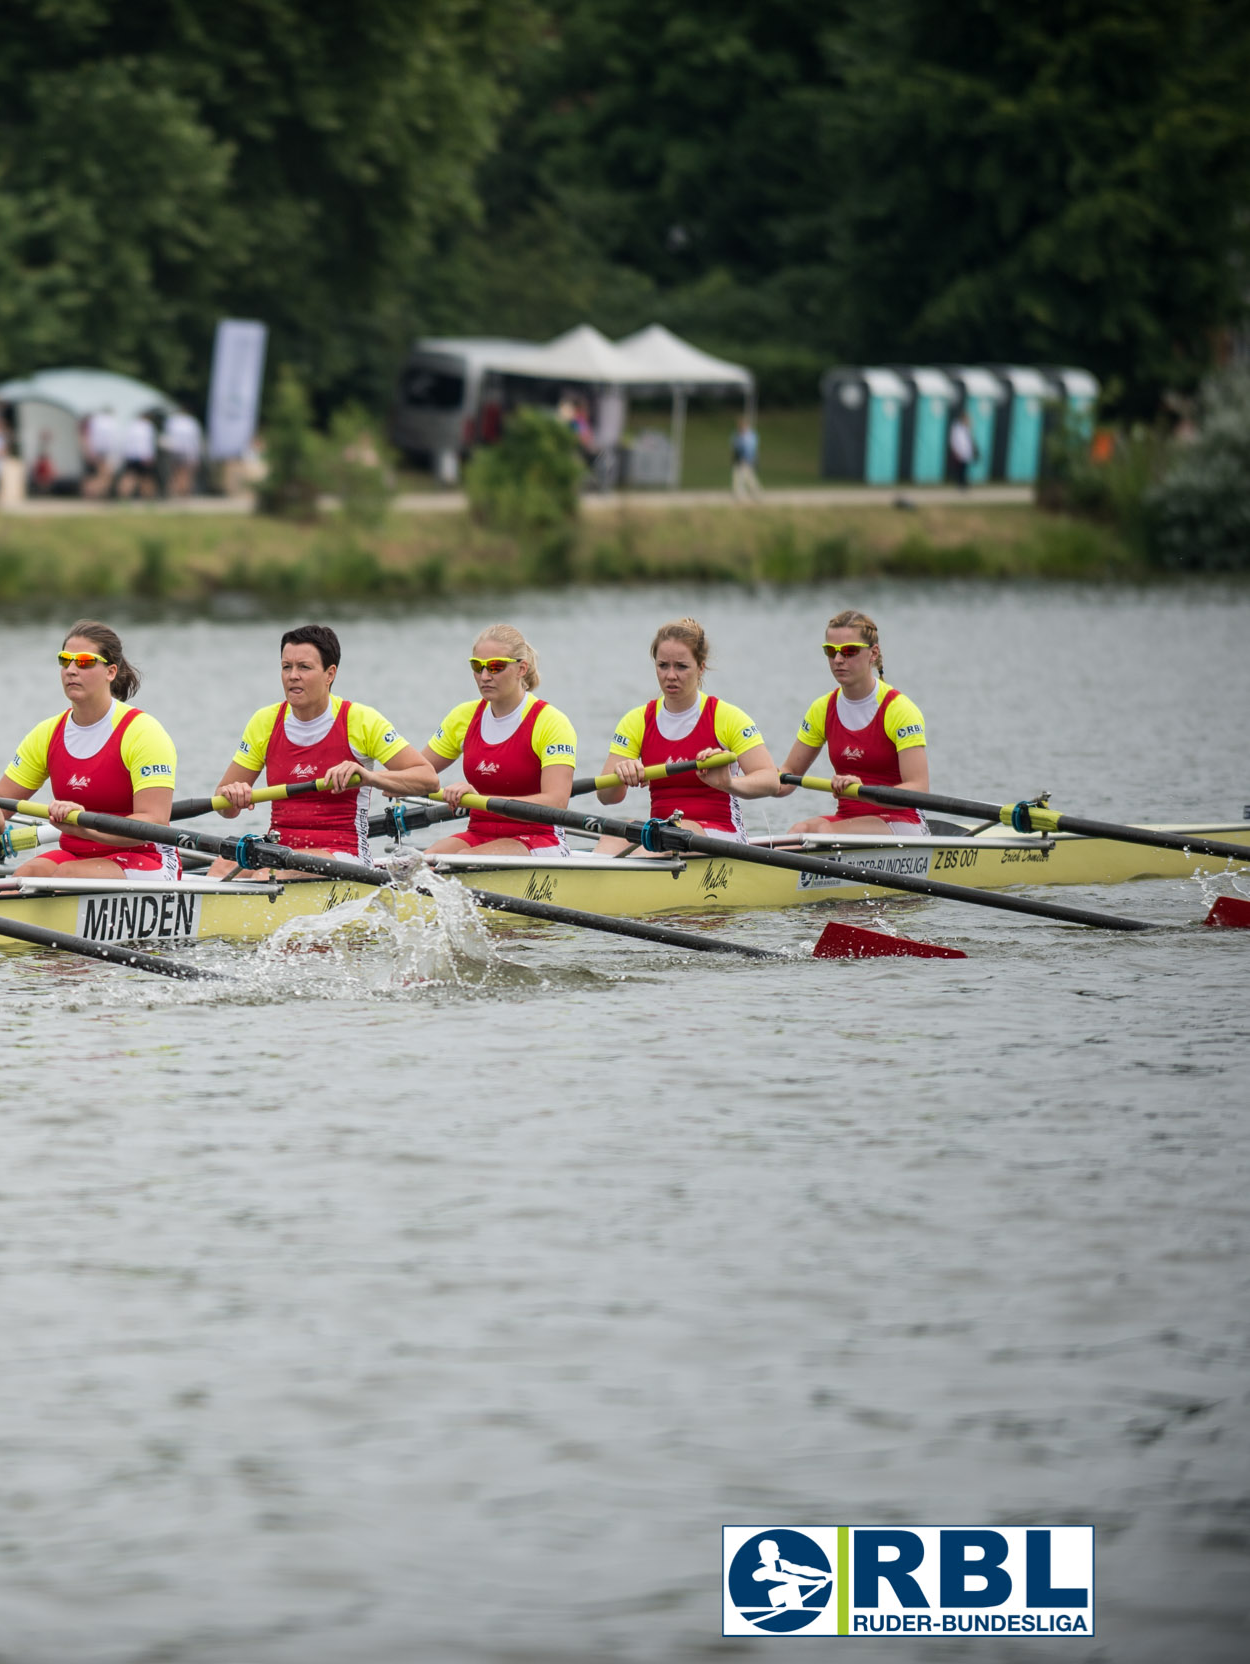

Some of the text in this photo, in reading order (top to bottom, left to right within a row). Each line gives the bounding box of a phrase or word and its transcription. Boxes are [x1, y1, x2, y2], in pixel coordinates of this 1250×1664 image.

[152, 764, 172, 774] RBL
[934, 848, 979, 869] Z BS 001
[522, 871, 554, 901] Melitta
[696, 859, 728, 892] Melitta
[82, 893, 195, 941] MINDEN
